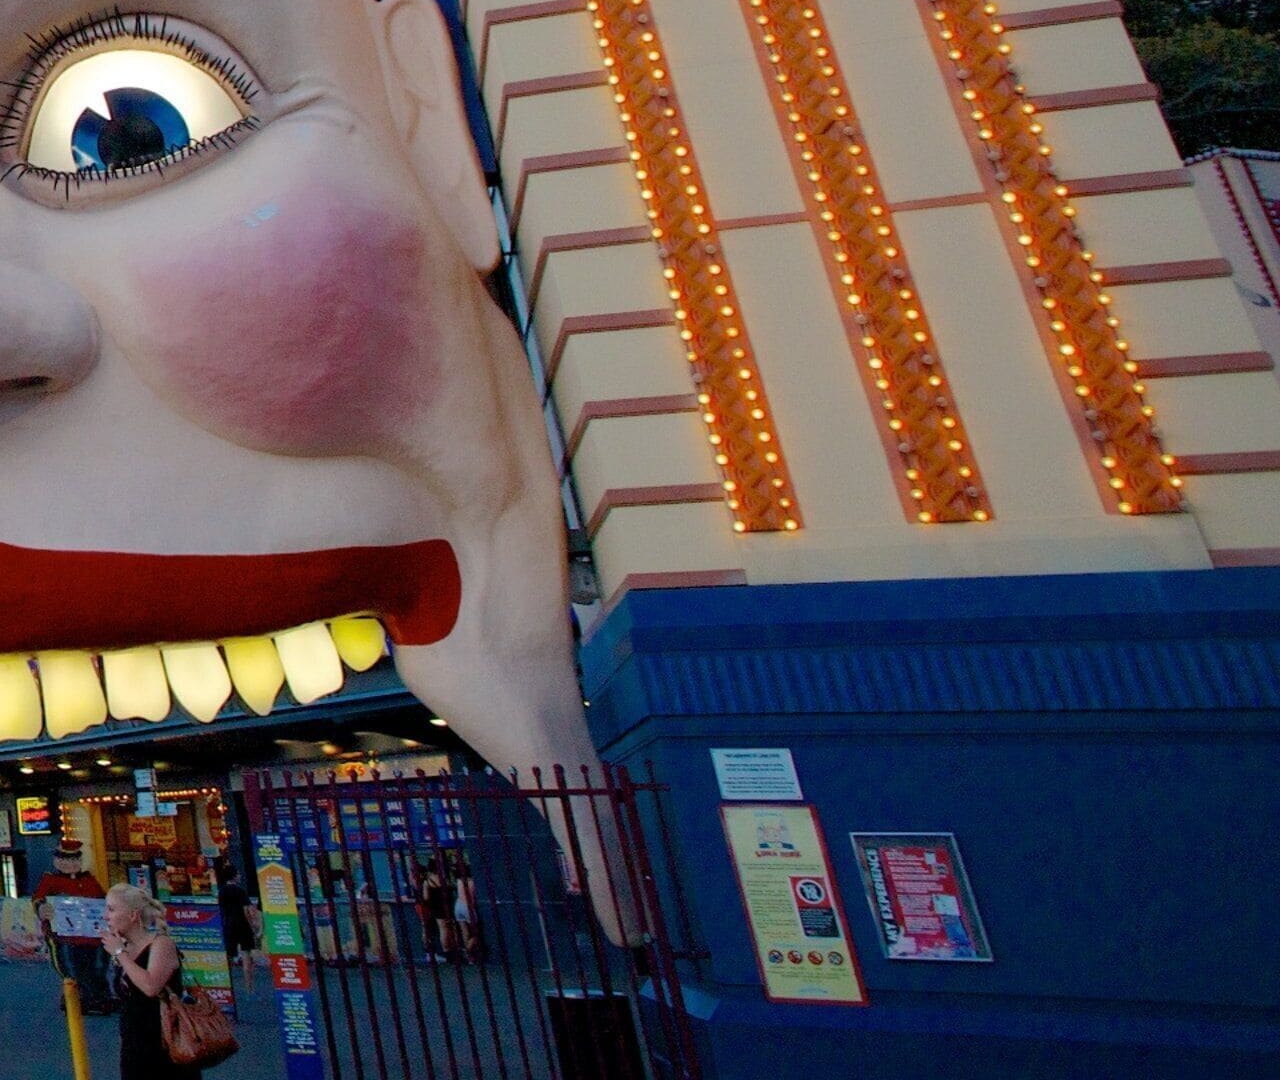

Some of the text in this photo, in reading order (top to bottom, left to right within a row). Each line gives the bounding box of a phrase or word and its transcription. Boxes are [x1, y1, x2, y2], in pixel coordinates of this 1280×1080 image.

[22, 810, 50, 821] SHOP
[23, 821, 49, 831] SHOP
[865, 848, 900, 945] MY EXPERIENCE
